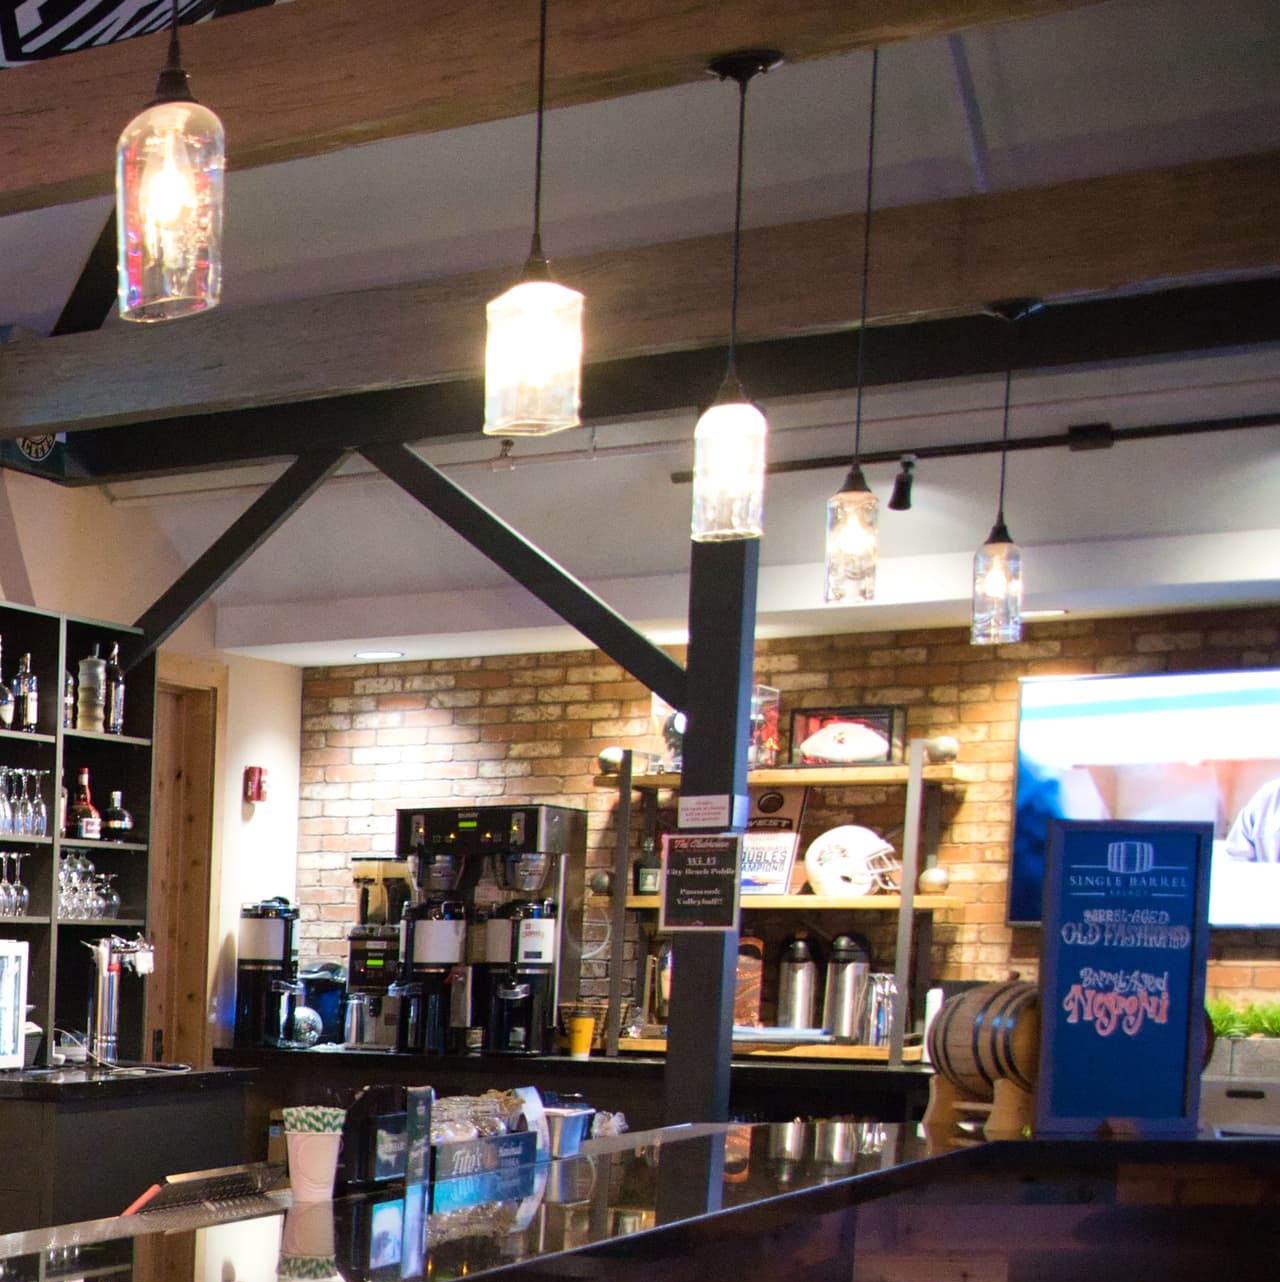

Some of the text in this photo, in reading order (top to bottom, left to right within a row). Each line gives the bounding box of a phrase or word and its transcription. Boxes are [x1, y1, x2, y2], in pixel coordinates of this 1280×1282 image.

[1069, 874, 1189, 888] SINGLE BARREL
[1061, 921, 1100, 946] OLD
[451, 1148, 483, 1175] Tito's
